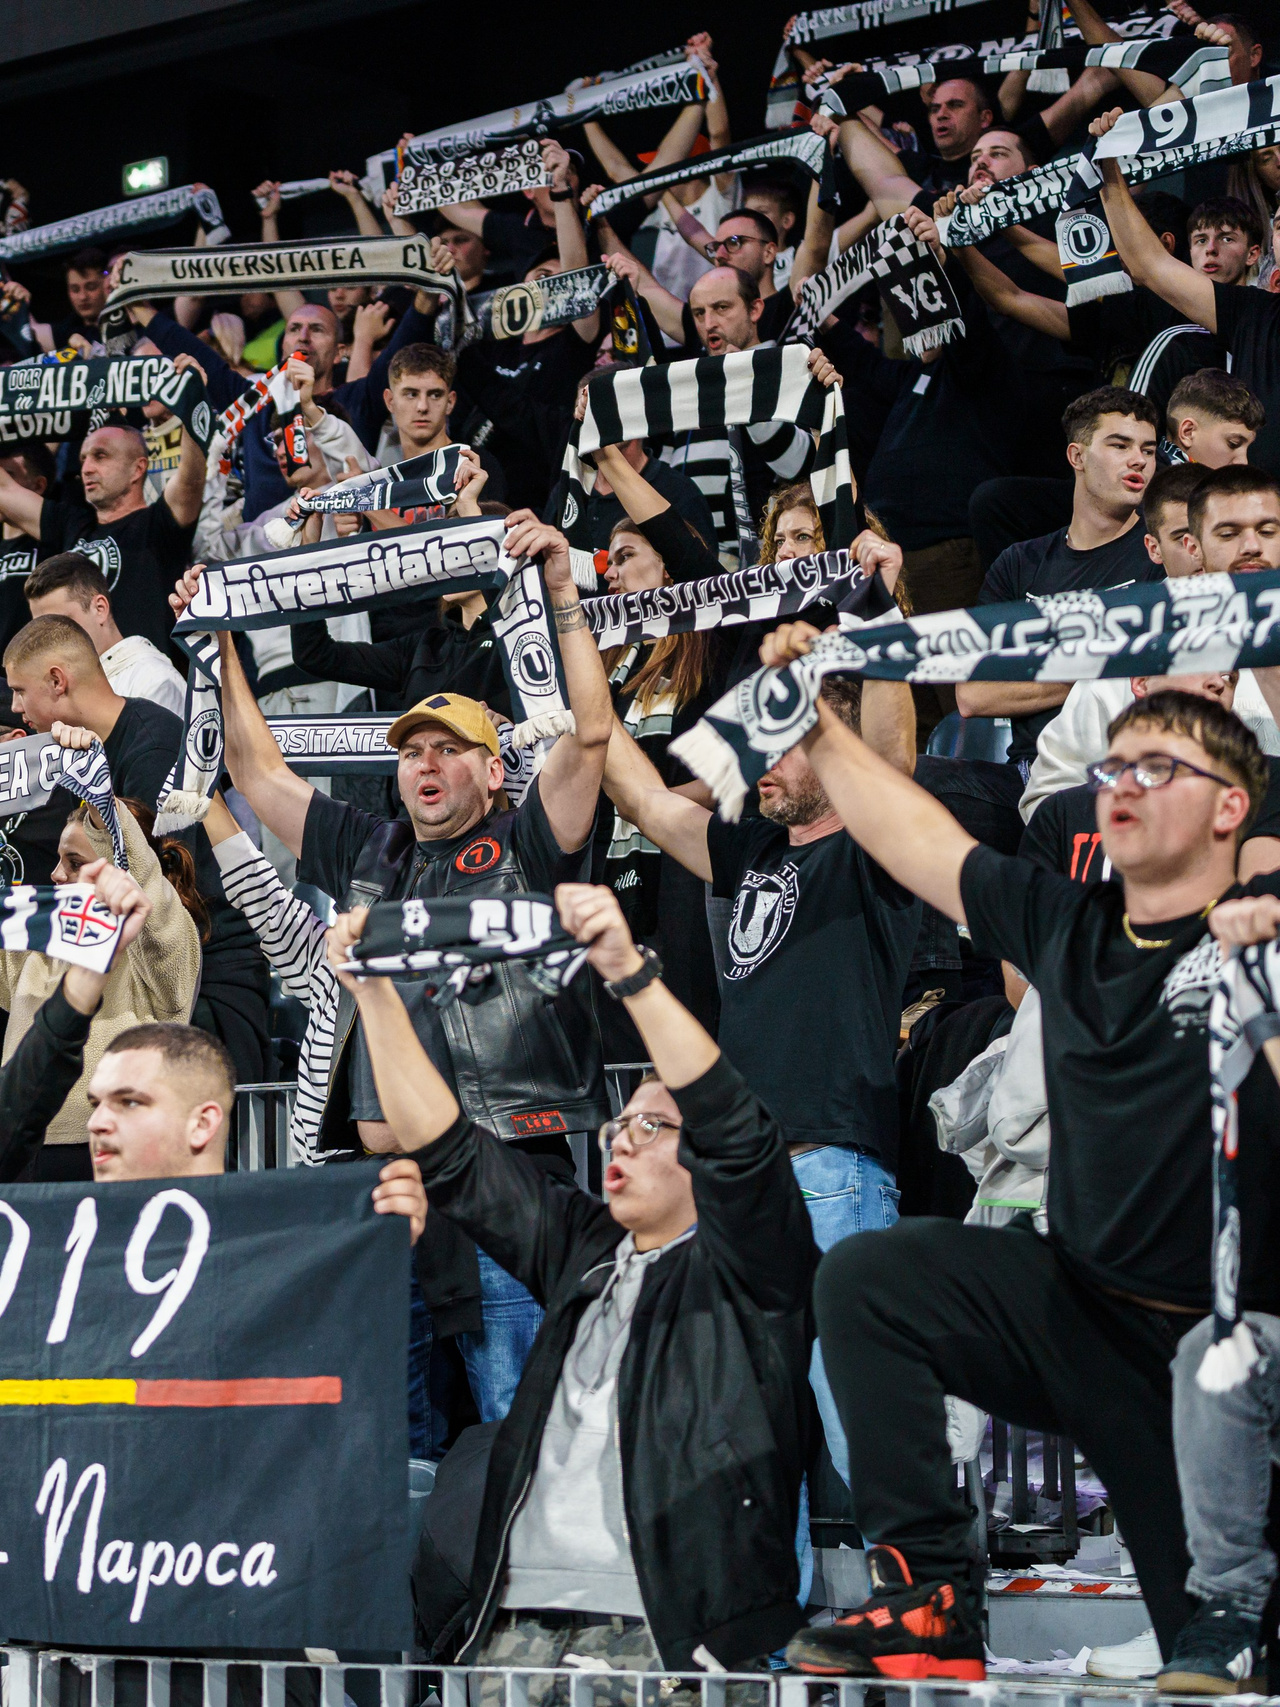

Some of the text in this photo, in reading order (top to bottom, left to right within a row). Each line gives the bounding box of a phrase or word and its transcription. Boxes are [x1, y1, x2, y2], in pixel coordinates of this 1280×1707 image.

[1072, 225, 1097, 254] U
[172, 247, 367, 280] UNIVERSITATEA
[402, 242, 437, 275] CL
[506, 295, 529, 332] U
[36, 365, 89, 409] ALB
[105, 360, 194, 406] NEGRU
[189, 535, 501, 619] Universitatea
[581, 564, 788, 635] NIVERSITATEA
[522, 649, 549, 682] U
[200, 727, 220, 759] U
[469, 846, 484, 864] 7
[730, 964, 755, 979] 1919
[525, 1118, 552, 1129] LEO
[34, 1457, 278, 1623] Napoca
